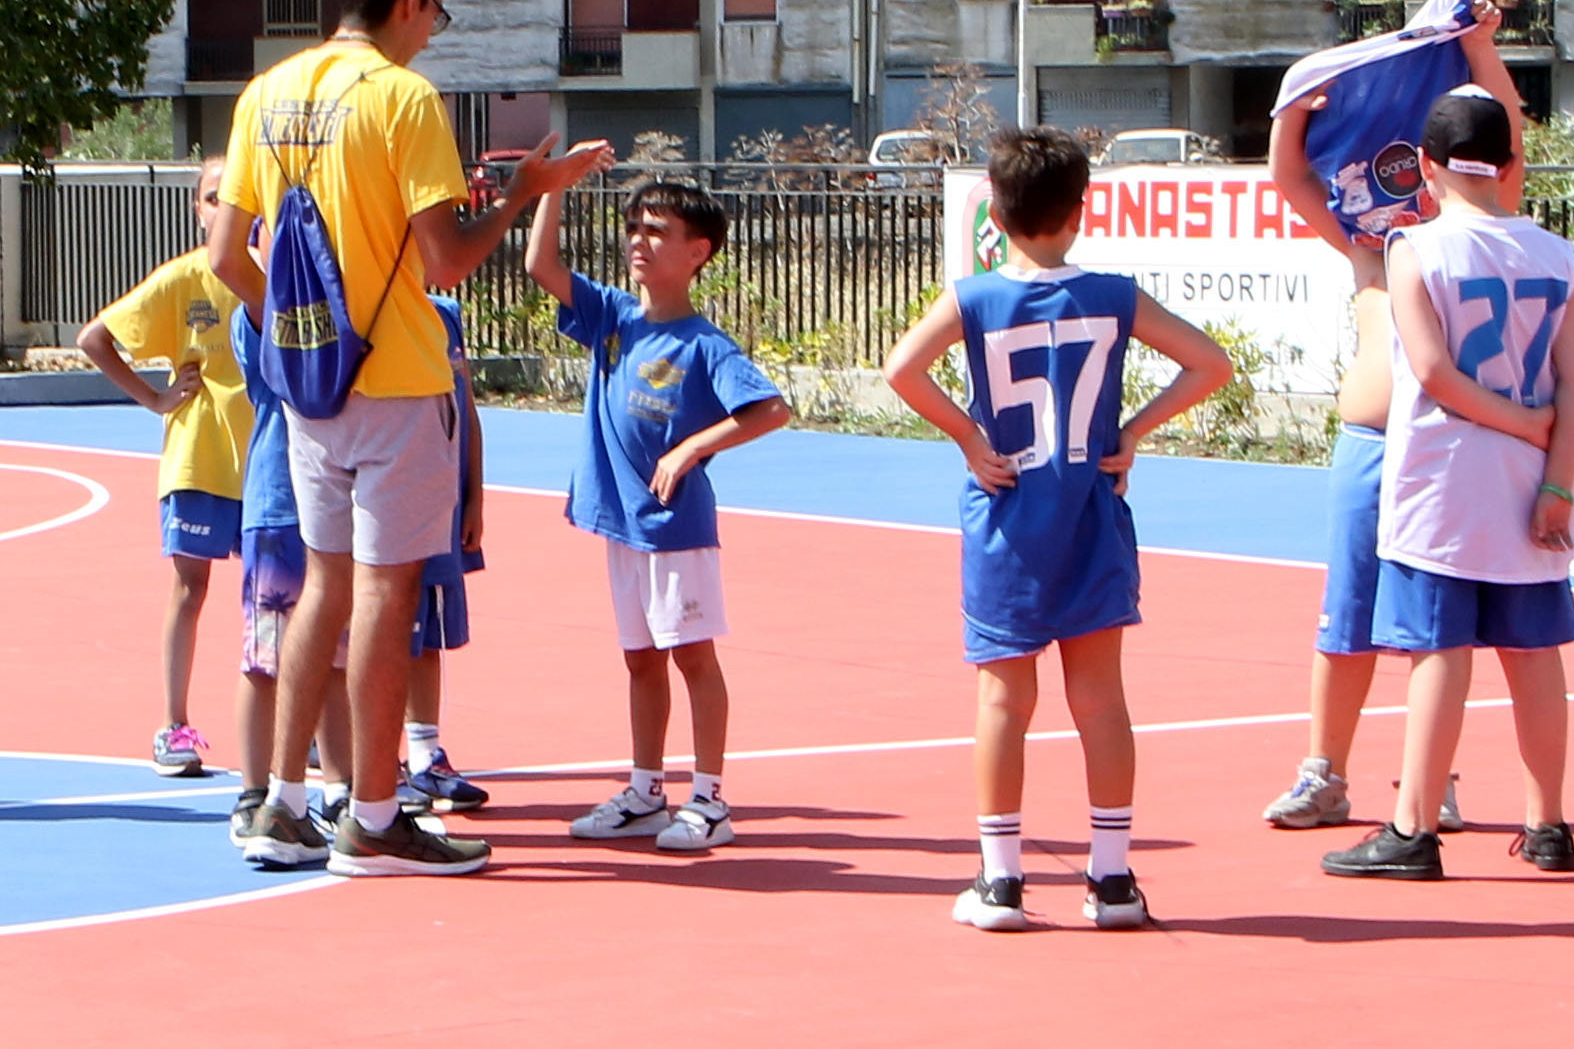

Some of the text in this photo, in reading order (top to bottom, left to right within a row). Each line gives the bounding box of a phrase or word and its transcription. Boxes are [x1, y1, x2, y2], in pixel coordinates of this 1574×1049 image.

[1183, 272, 1308, 302] SPORTIVI
[1457, 277, 1568, 408] 27
[984, 316, 1119, 474] 57
